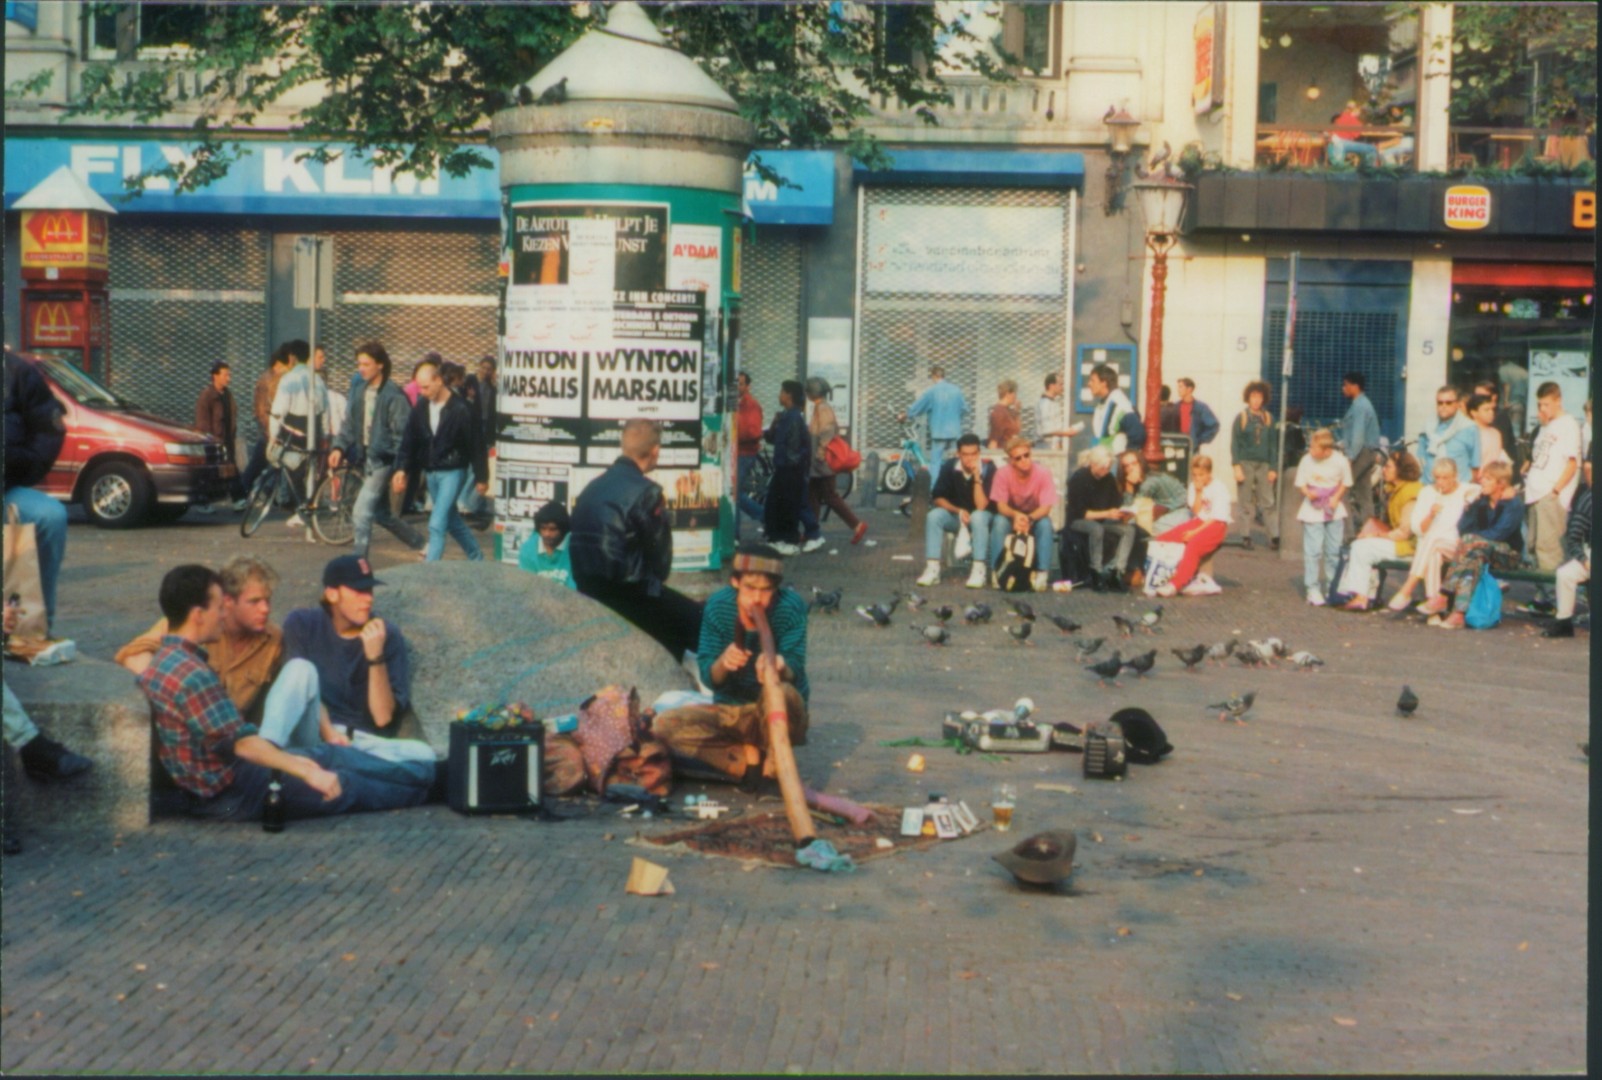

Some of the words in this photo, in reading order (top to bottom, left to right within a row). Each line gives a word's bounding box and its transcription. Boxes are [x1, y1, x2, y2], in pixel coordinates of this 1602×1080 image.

[263, 147, 440, 195] KLM
[1447, 195, 1487, 207] BURGER
[1447, 207, 1486, 220] KING
[672, 243, 719, 259] A'DAM
[1236, 336, 1248, 353] 5
[1422, 340, 1434, 356] 5
[504, 349, 577, 371] WYNTON
[596, 348, 698, 374] WYNTON
[502, 374, 579, 400] MARSALIS
[592, 377, 698, 403] MARSALIS
[515, 480, 555, 501] LABI
